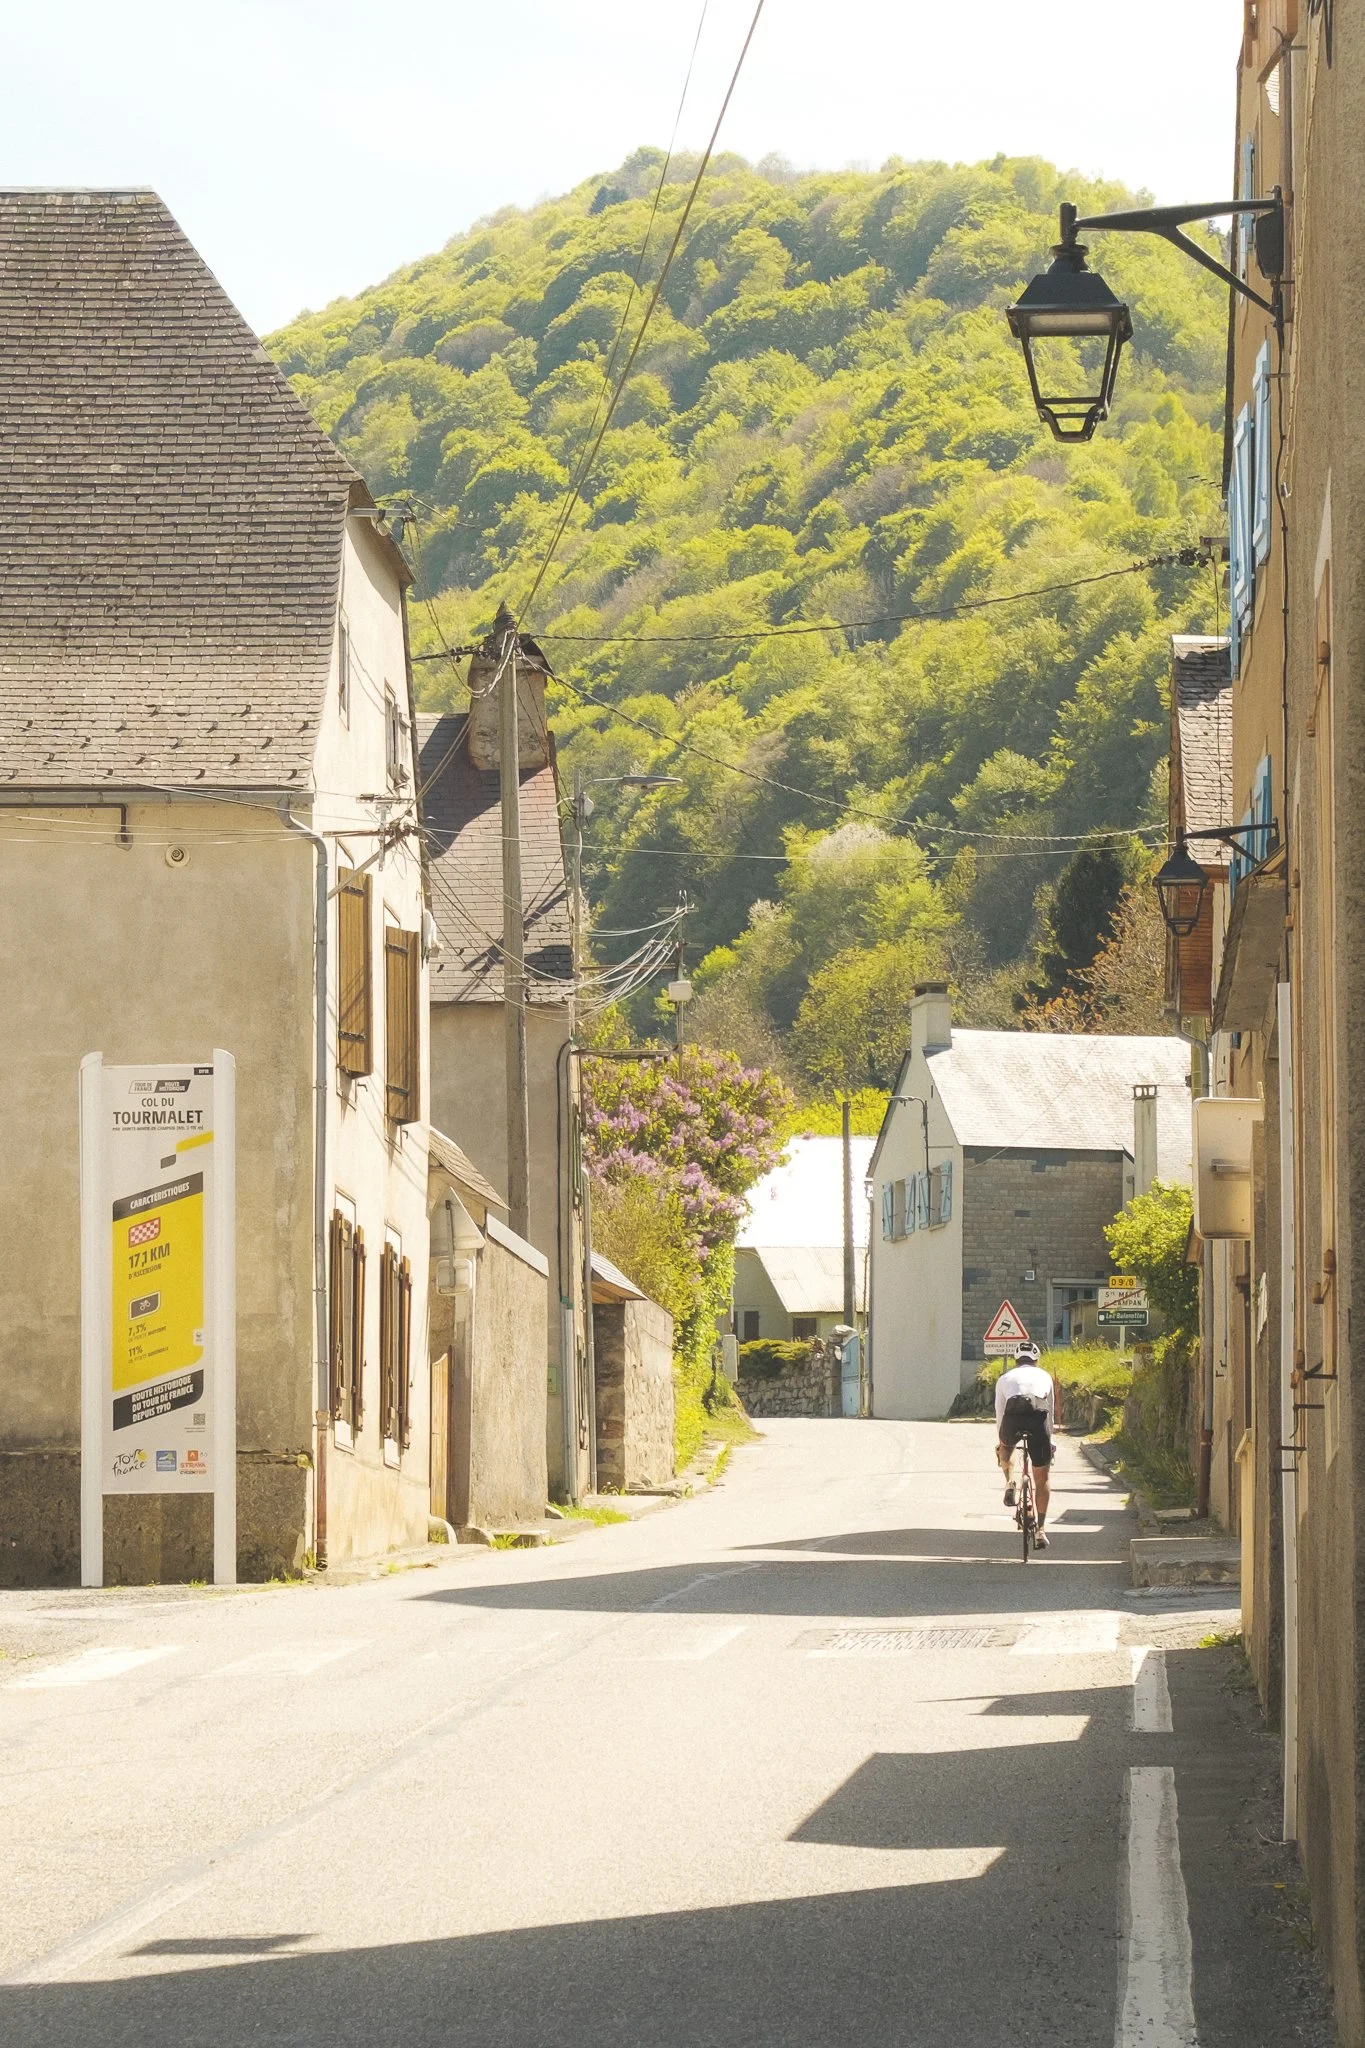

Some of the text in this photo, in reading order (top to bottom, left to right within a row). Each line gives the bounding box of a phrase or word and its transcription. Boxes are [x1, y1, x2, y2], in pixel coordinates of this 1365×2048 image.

[141, 1097, 175, 1107] COL DU
[112, 1110, 204, 1125] TOURMALET
[128, 1242, 170, 1269] 17,1 KM
[1111, 1278, 1117, 1286] D
[131, 1375, 192, 1403] ROUTE HISTORIQUE
[132, 1384, 194, 1413] DU TOUR DE FRANCE
[132, 1401, 171, 1423] DEPUIS 1910
